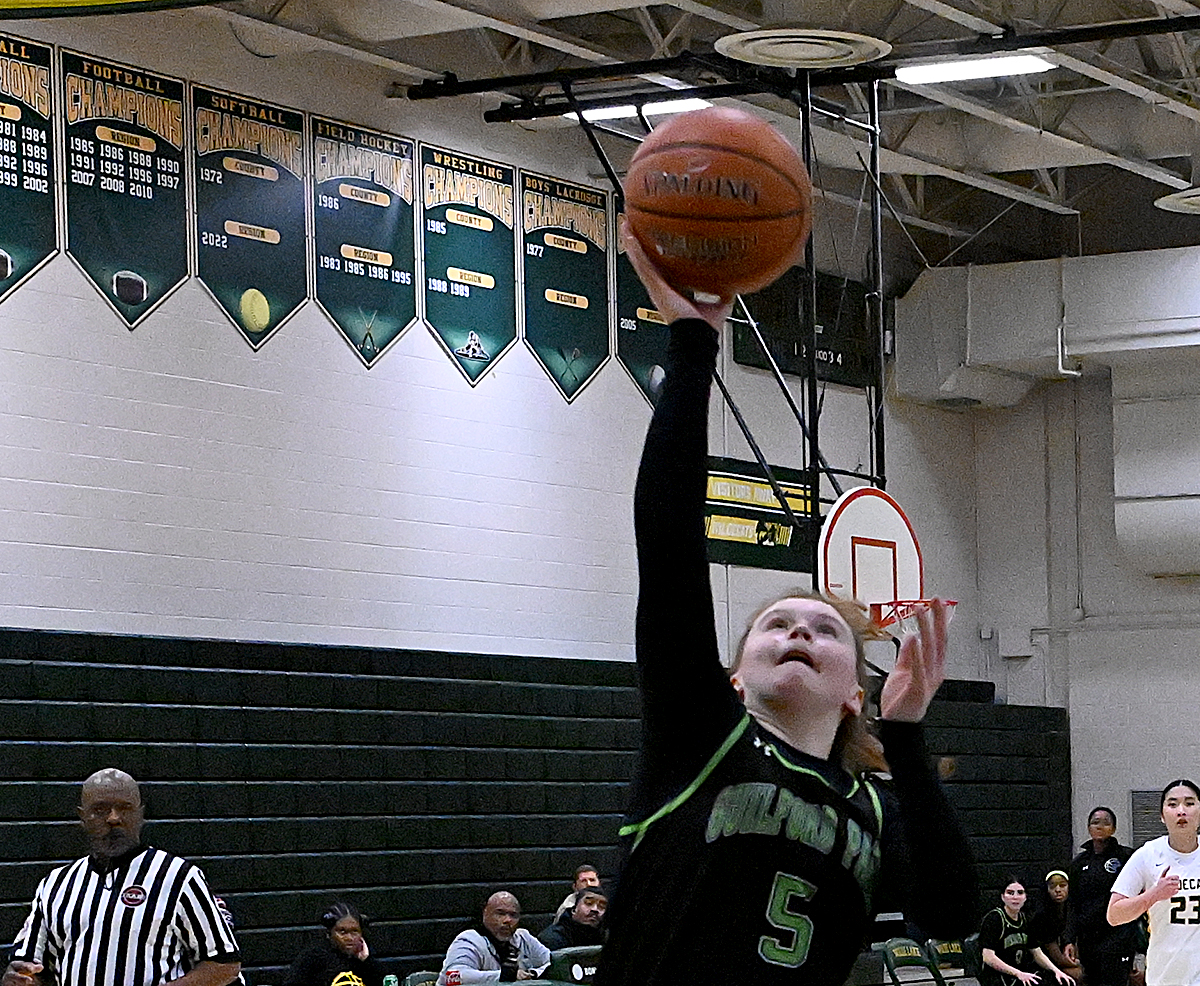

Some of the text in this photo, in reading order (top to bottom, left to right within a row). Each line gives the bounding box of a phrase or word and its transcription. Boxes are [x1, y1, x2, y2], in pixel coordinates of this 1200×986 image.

[82, 61, 165, 94] FOOTBALL
[65, 72, 183, 152] CHAMPIONS
[211, 95, 286, 124] SOFTBALL
[22, 125, 47, 143] 1984
[196, 106, 303, 180] CHAMPIONS
[317, 122, 408, 156] FIELD HOCKEY
[22, 142, 48, 161] 1989
[70, 136, 180, 174] 1985 1986 1988 1990
[22, 158, 48, 176] 1996
[70, 153, 180, 190] 1991 1992 1996 1997
[200, 167, 223, 185] 1972
[314, 136, 413, 206] CHAMPIONS
[432, 151, 503, 180] WRESTLING
[23, 175, 49, 194] 2002
[71, 169, 153, 199] 2007 2008 2010
[350, 187, 378, 202] COUNTY
[526, 176, 603, 206] BOYS LACROSSE
[318, 194, 340, 210] 1986
[423, 163, 514, 231] CHAMPIONS
[426, 218, 447, 235] 1985
[456, 213, 482, 227] COUNTY
[524, 189, 606, 252] CHAMPIONS
[201, 231, 228, 249] 2022
[526, 243, 544, 258] 1977
[353, 248, 379, 262] REGION
[320, 255, 411, 285] 1983 1985 1986 1995
[459, 271, 482, 284] REGION
[428, 277, 470, 298] 1988 1989
[620, 317, 637, 331] 2005
[757, 871, 818, 969] 5
